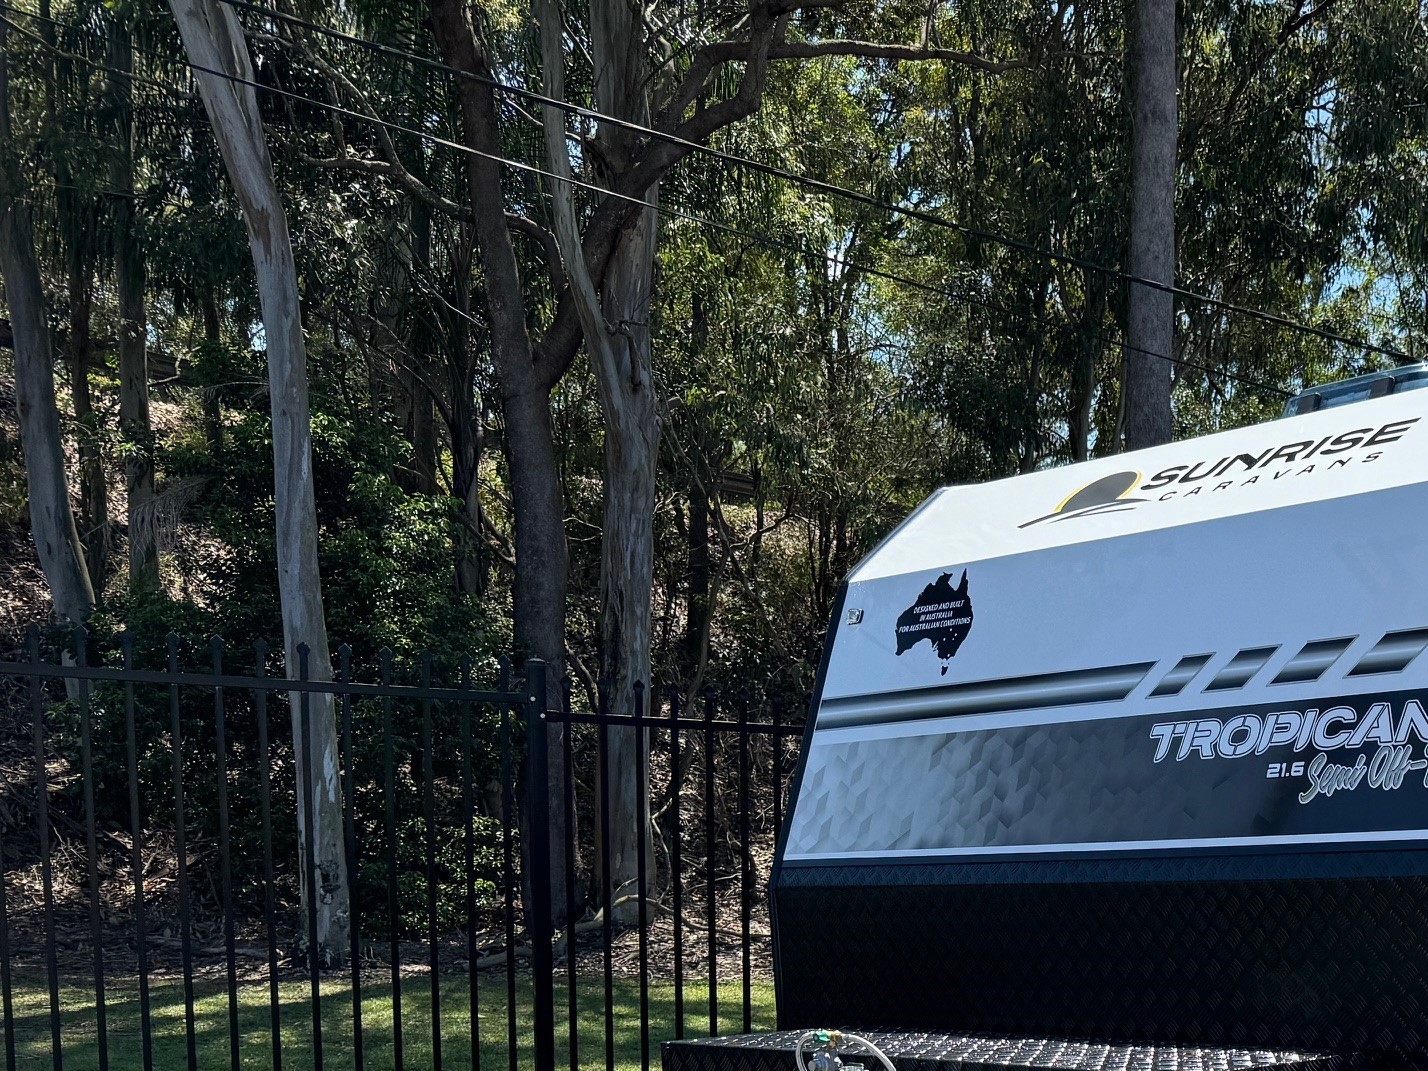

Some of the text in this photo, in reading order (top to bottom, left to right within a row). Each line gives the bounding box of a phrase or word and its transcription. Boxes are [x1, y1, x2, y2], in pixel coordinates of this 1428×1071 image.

[1140, 417, 1422, 490] SUNRISE
[1158, 451, 1384, 501] CARAVANS
[909, 622, 940, 632] AUSTRALIAN
[940, 617, 971, 627] CONDITIONS
[926, 611, 953, 620] AUSTRALIA
[1266, 761, 1305, 779] 21.6
[1299, 752, 1367, 804] Semi
